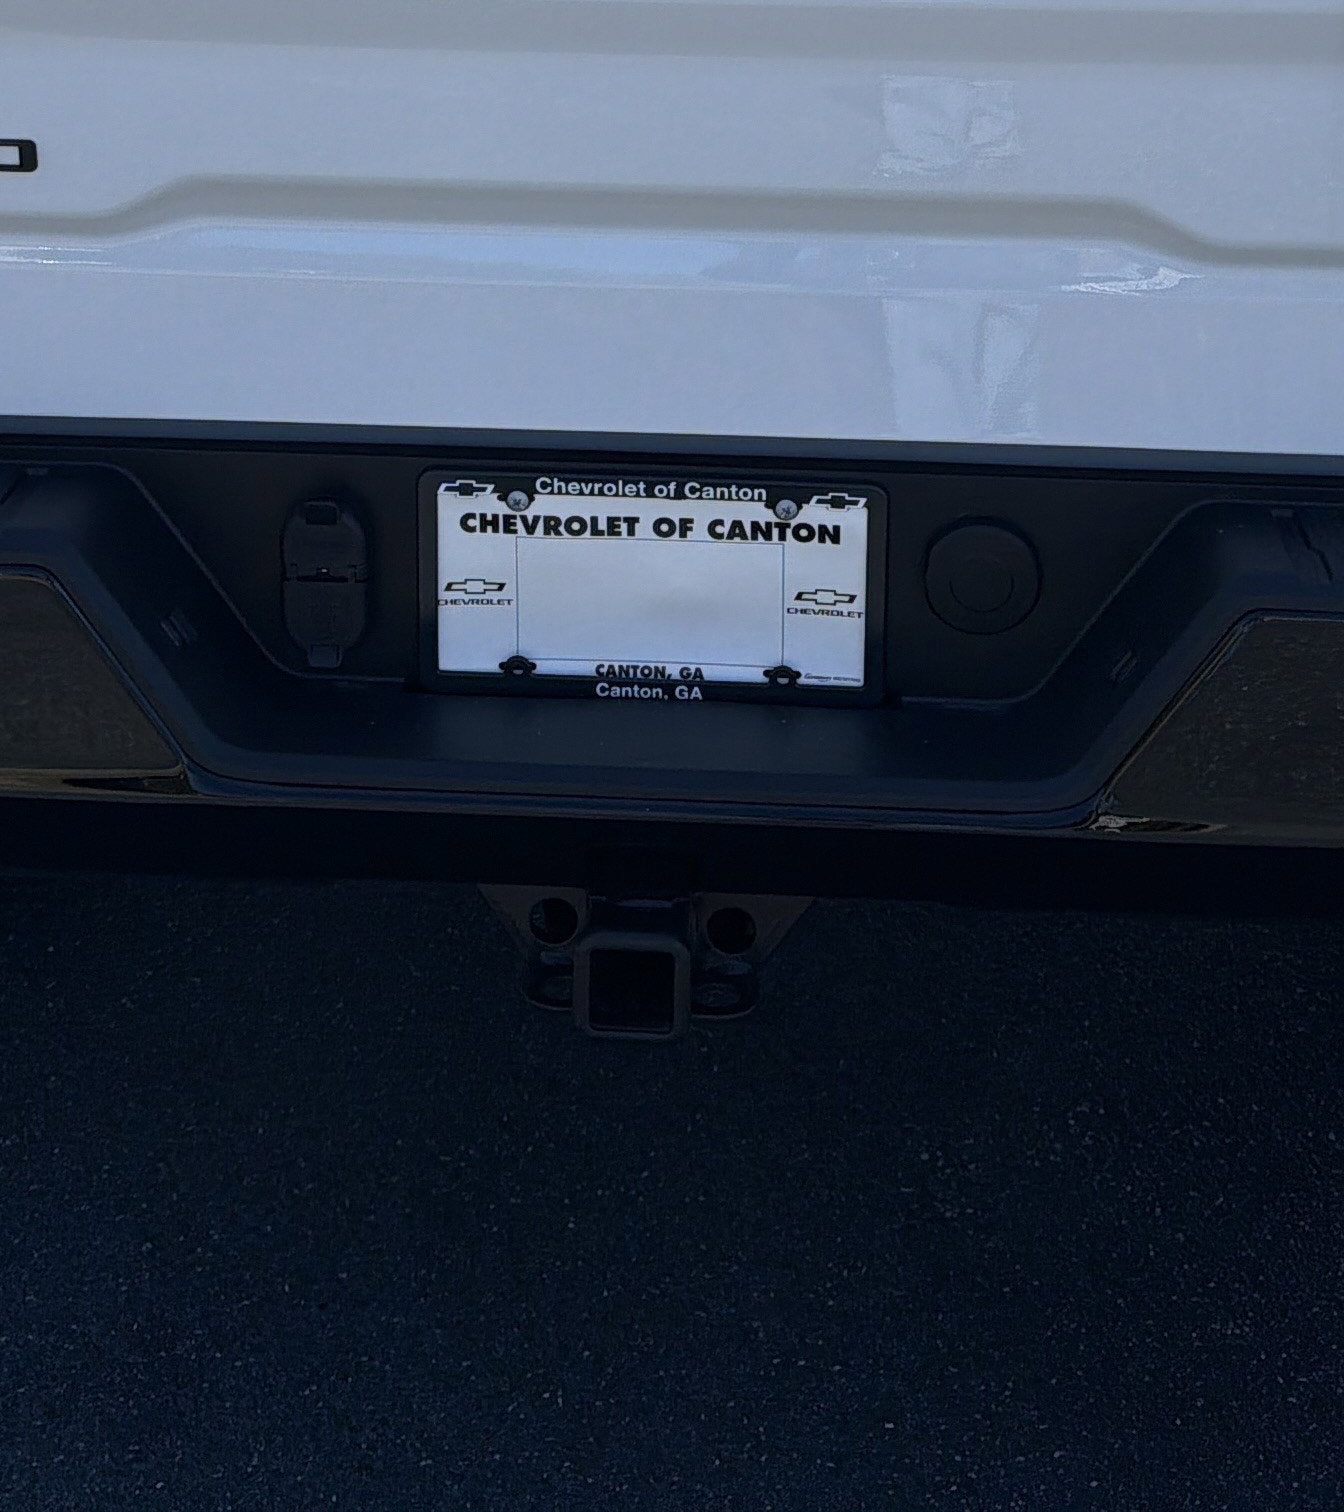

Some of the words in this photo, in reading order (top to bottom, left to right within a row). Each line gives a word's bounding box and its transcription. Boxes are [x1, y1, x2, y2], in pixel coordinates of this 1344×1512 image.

[535, 477, 646, 497] Chevrolet
[654, 481, 677, 498] of
[684, 482, 767, 501] Canton
[460, 512, 640, 537] CHEVROLET
[652, 517, 694, 539] OF
[707, 519, 841, 545] CANTON
[437, 598, 514, 606] CHEVROLET
[786, 608, 864, 619] CHEVROLET
[595, 663, 673, 680] CANTON,
[678, 667, 705, 681] GA
[675, 685, 704, 701] GA
